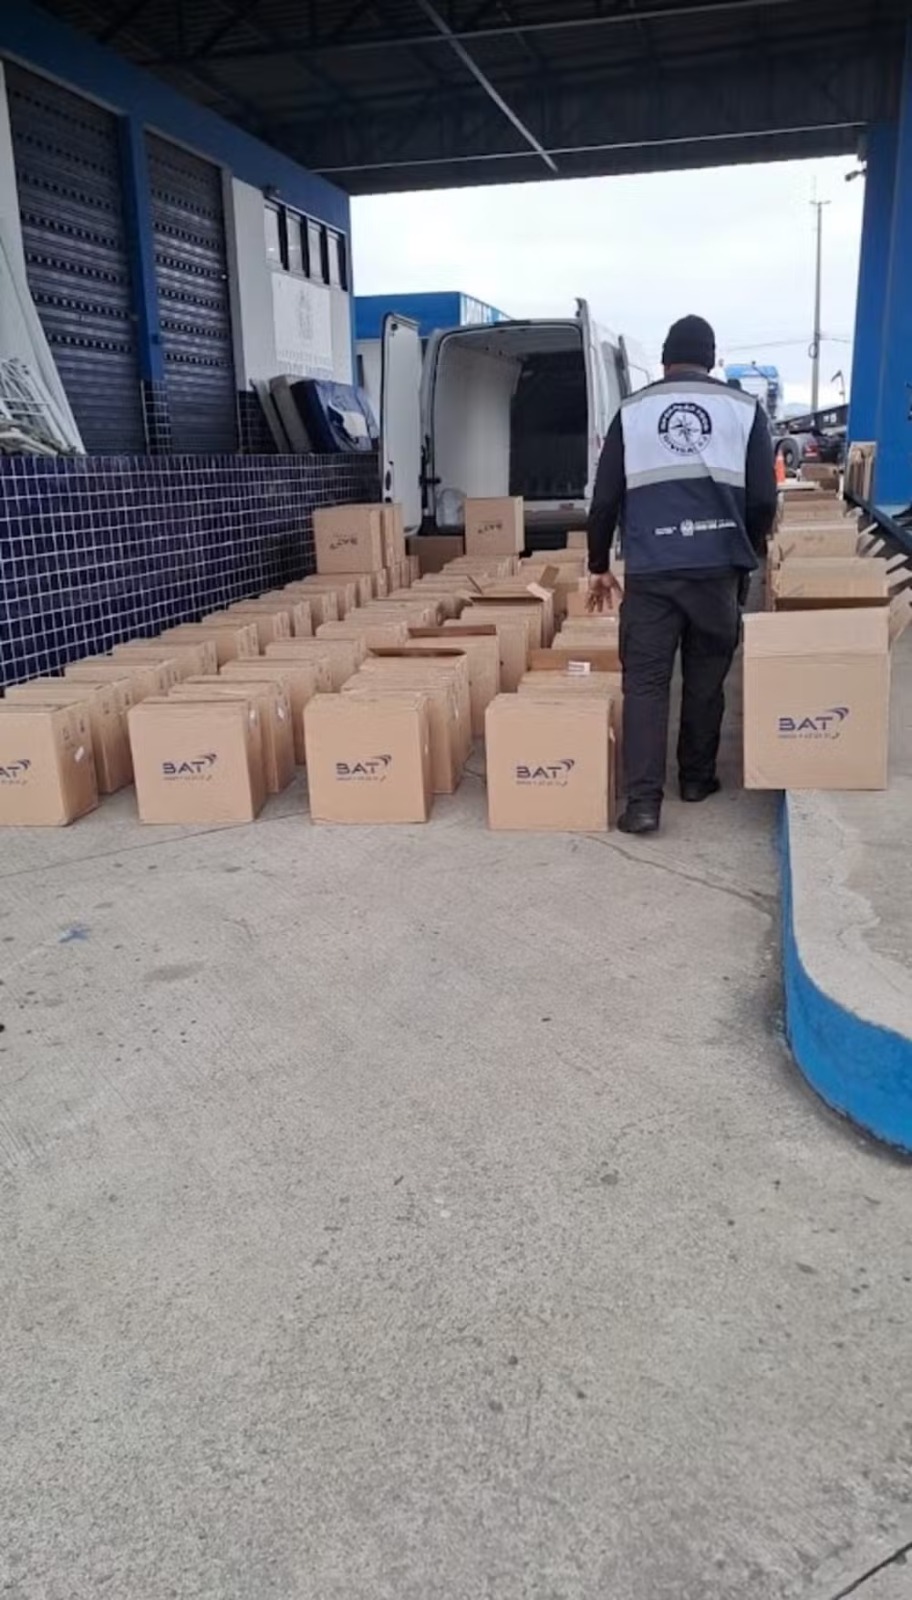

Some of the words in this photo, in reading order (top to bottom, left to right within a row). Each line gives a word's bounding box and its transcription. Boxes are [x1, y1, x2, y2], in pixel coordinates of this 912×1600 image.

[779, 717, 833, 731] BAT
[0, 767, 20, 778] AT
[163, 762, 205, 774] BAT
[336, 762, 379, 774] BAT
[516, 766, 562, 779] BAT
